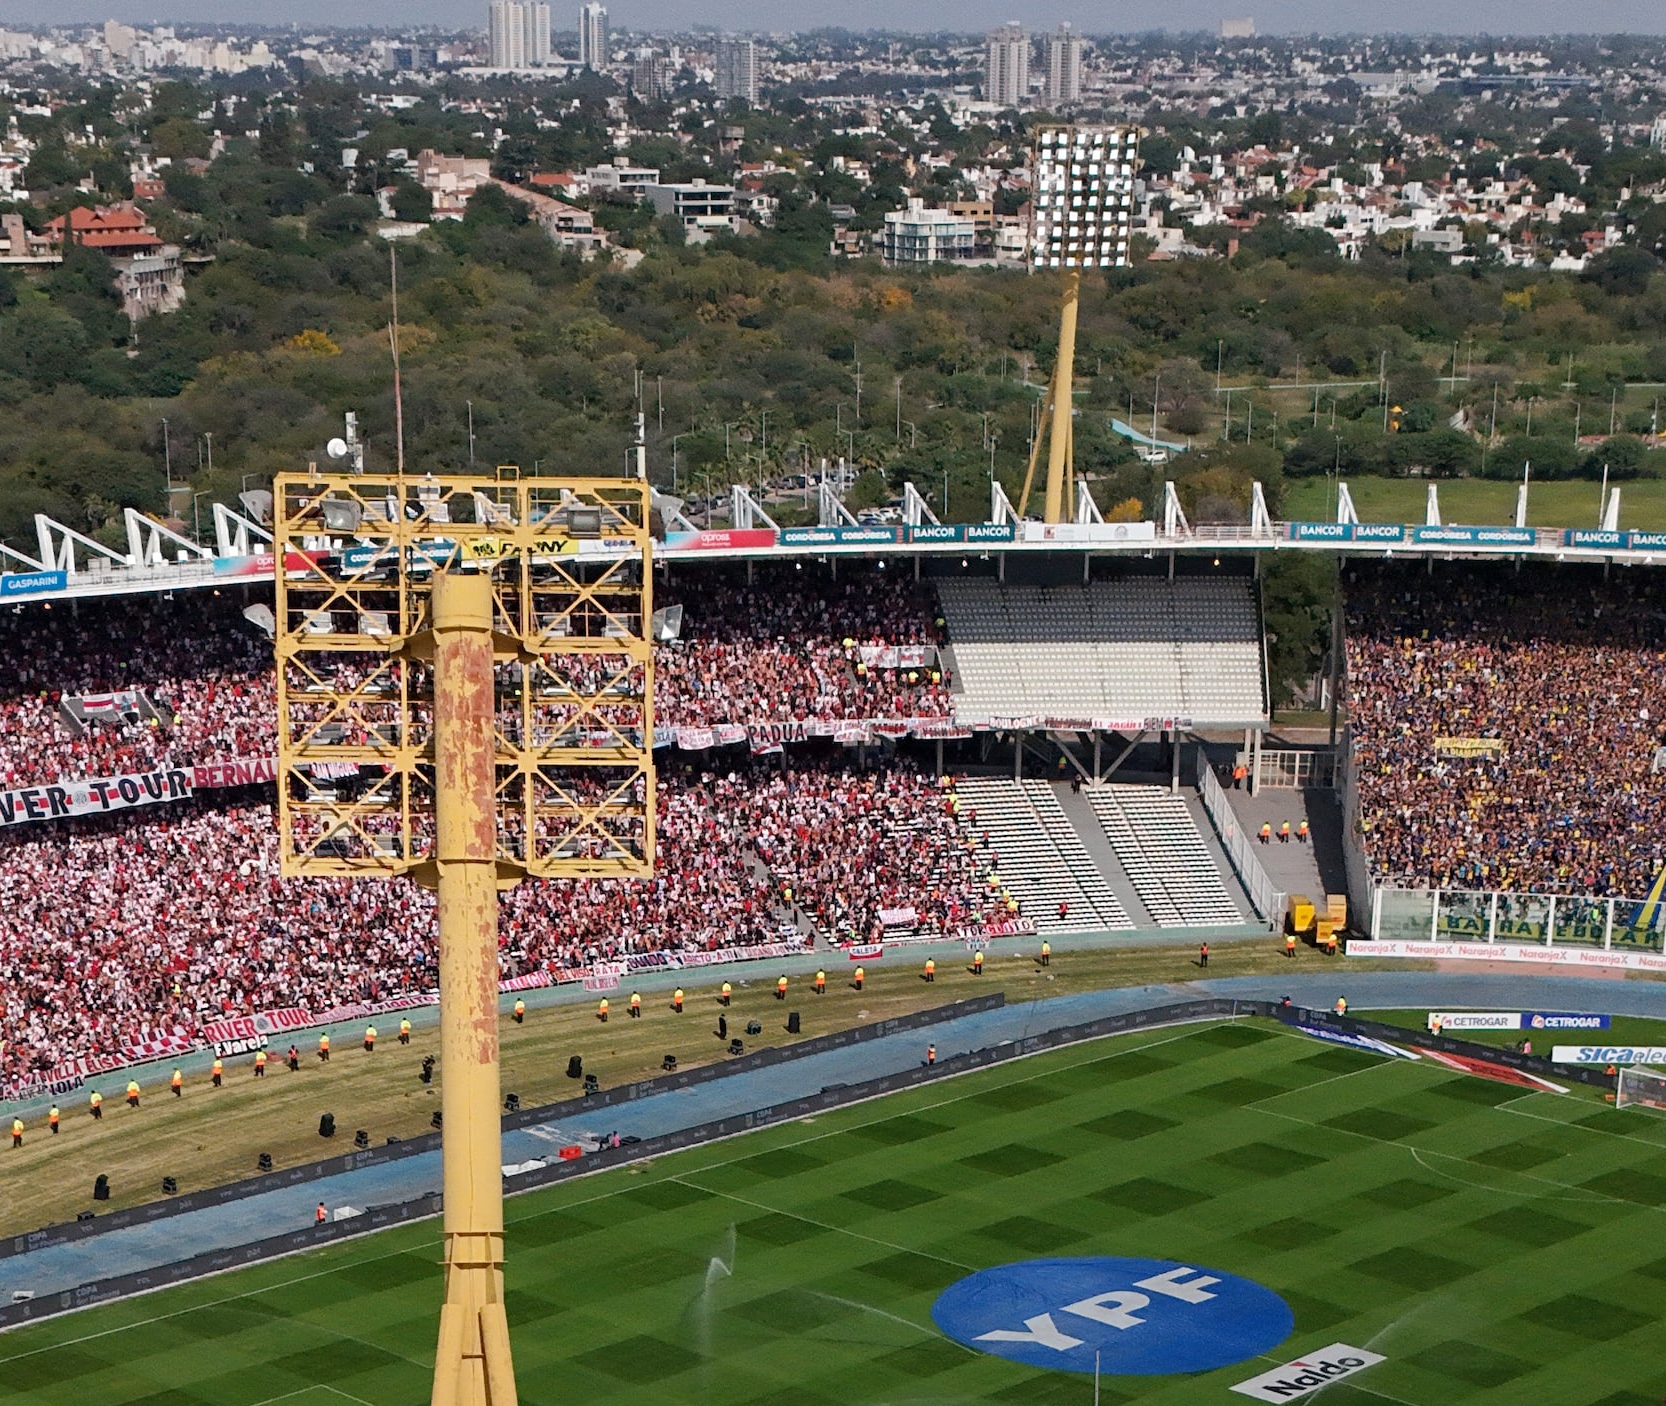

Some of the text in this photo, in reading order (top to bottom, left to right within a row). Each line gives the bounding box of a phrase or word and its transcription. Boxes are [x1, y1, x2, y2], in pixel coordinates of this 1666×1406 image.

[785, 530, 891, 541] CORDOBESA CORDOBESA
[914, 526, 1010, 537] BANCOR BANCOR
[1301, 526, 1399, 537] BANCOR BANCOR
[1420, 530, 1531, 541] CORDOBESA CORDOBESA
[1575, 533, 1619, 543] BANCOR
[8, 575, 57, 589] GASPARINI
[748, 723, 805, 742] PADUA
[194, 761, 276, 787] BERNAL
[90, 771, 189, 809] TOUR
[204, 1016, 258, 1042] RIVER
[265, 1008, 313, 1030] TOUR
[1454, 1017, 1508, 1027] CETROGAR
[1545, 1017, 1600, 1028] CETROGAR
[214, 1035, 268, 1057] F.Varela
[46, 1053, 124, 1082] VILLA ELISA
[971, 1266, 1222, 1351] YPF
[1262, 1357, 1365, 1397] Naldo
